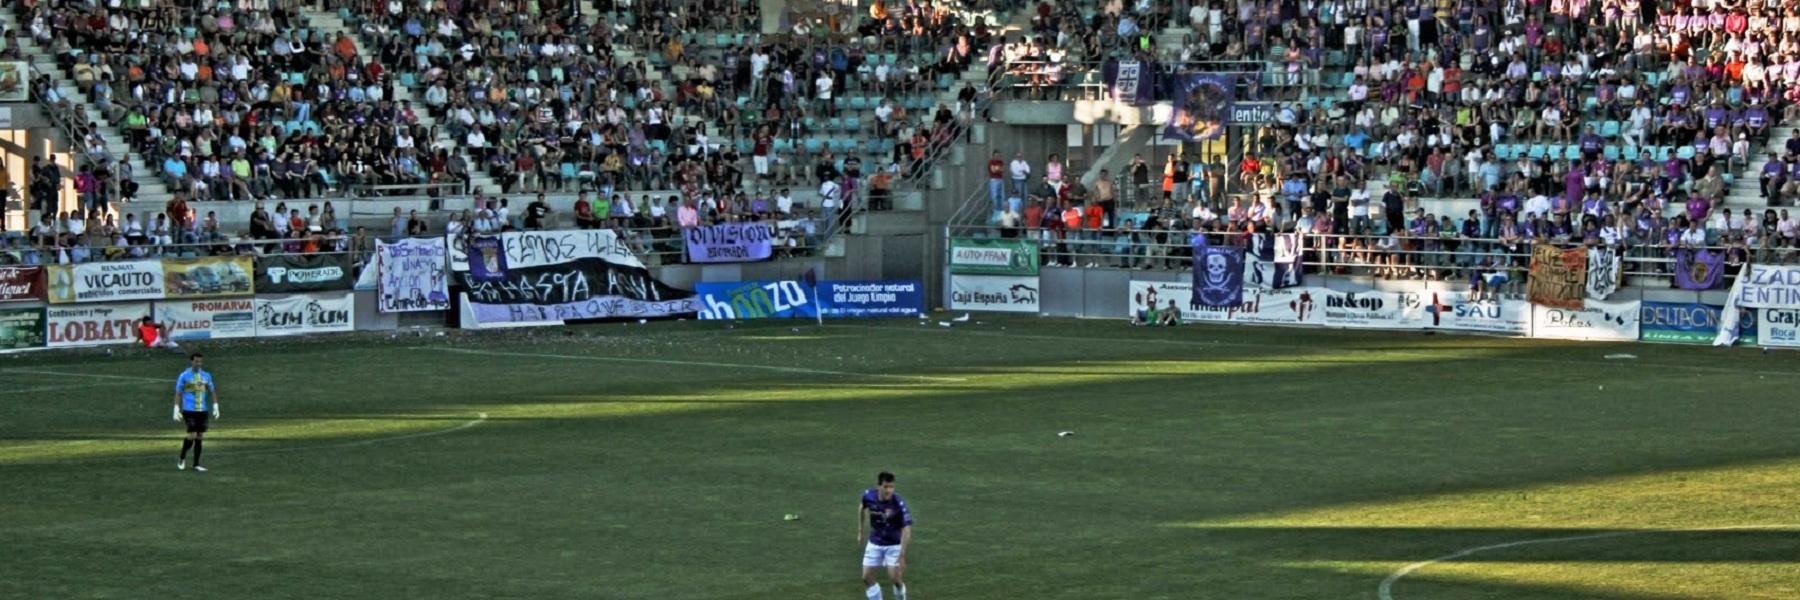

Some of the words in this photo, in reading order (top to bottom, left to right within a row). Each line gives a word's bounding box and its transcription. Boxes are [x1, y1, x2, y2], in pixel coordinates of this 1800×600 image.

[84, 271, 153, 289] VICAUTO
[289, 268, 341, 280] POWERADE
[832, 282, 883, 292] Patrocinador
[885, 282, 914, 292] natural
[871, 291, 896, 304] Limpio
[952, 291, 971, 305] Caja
[974, 291, 1008, 305] España
[1456, 304, 1502, 318] SAU
